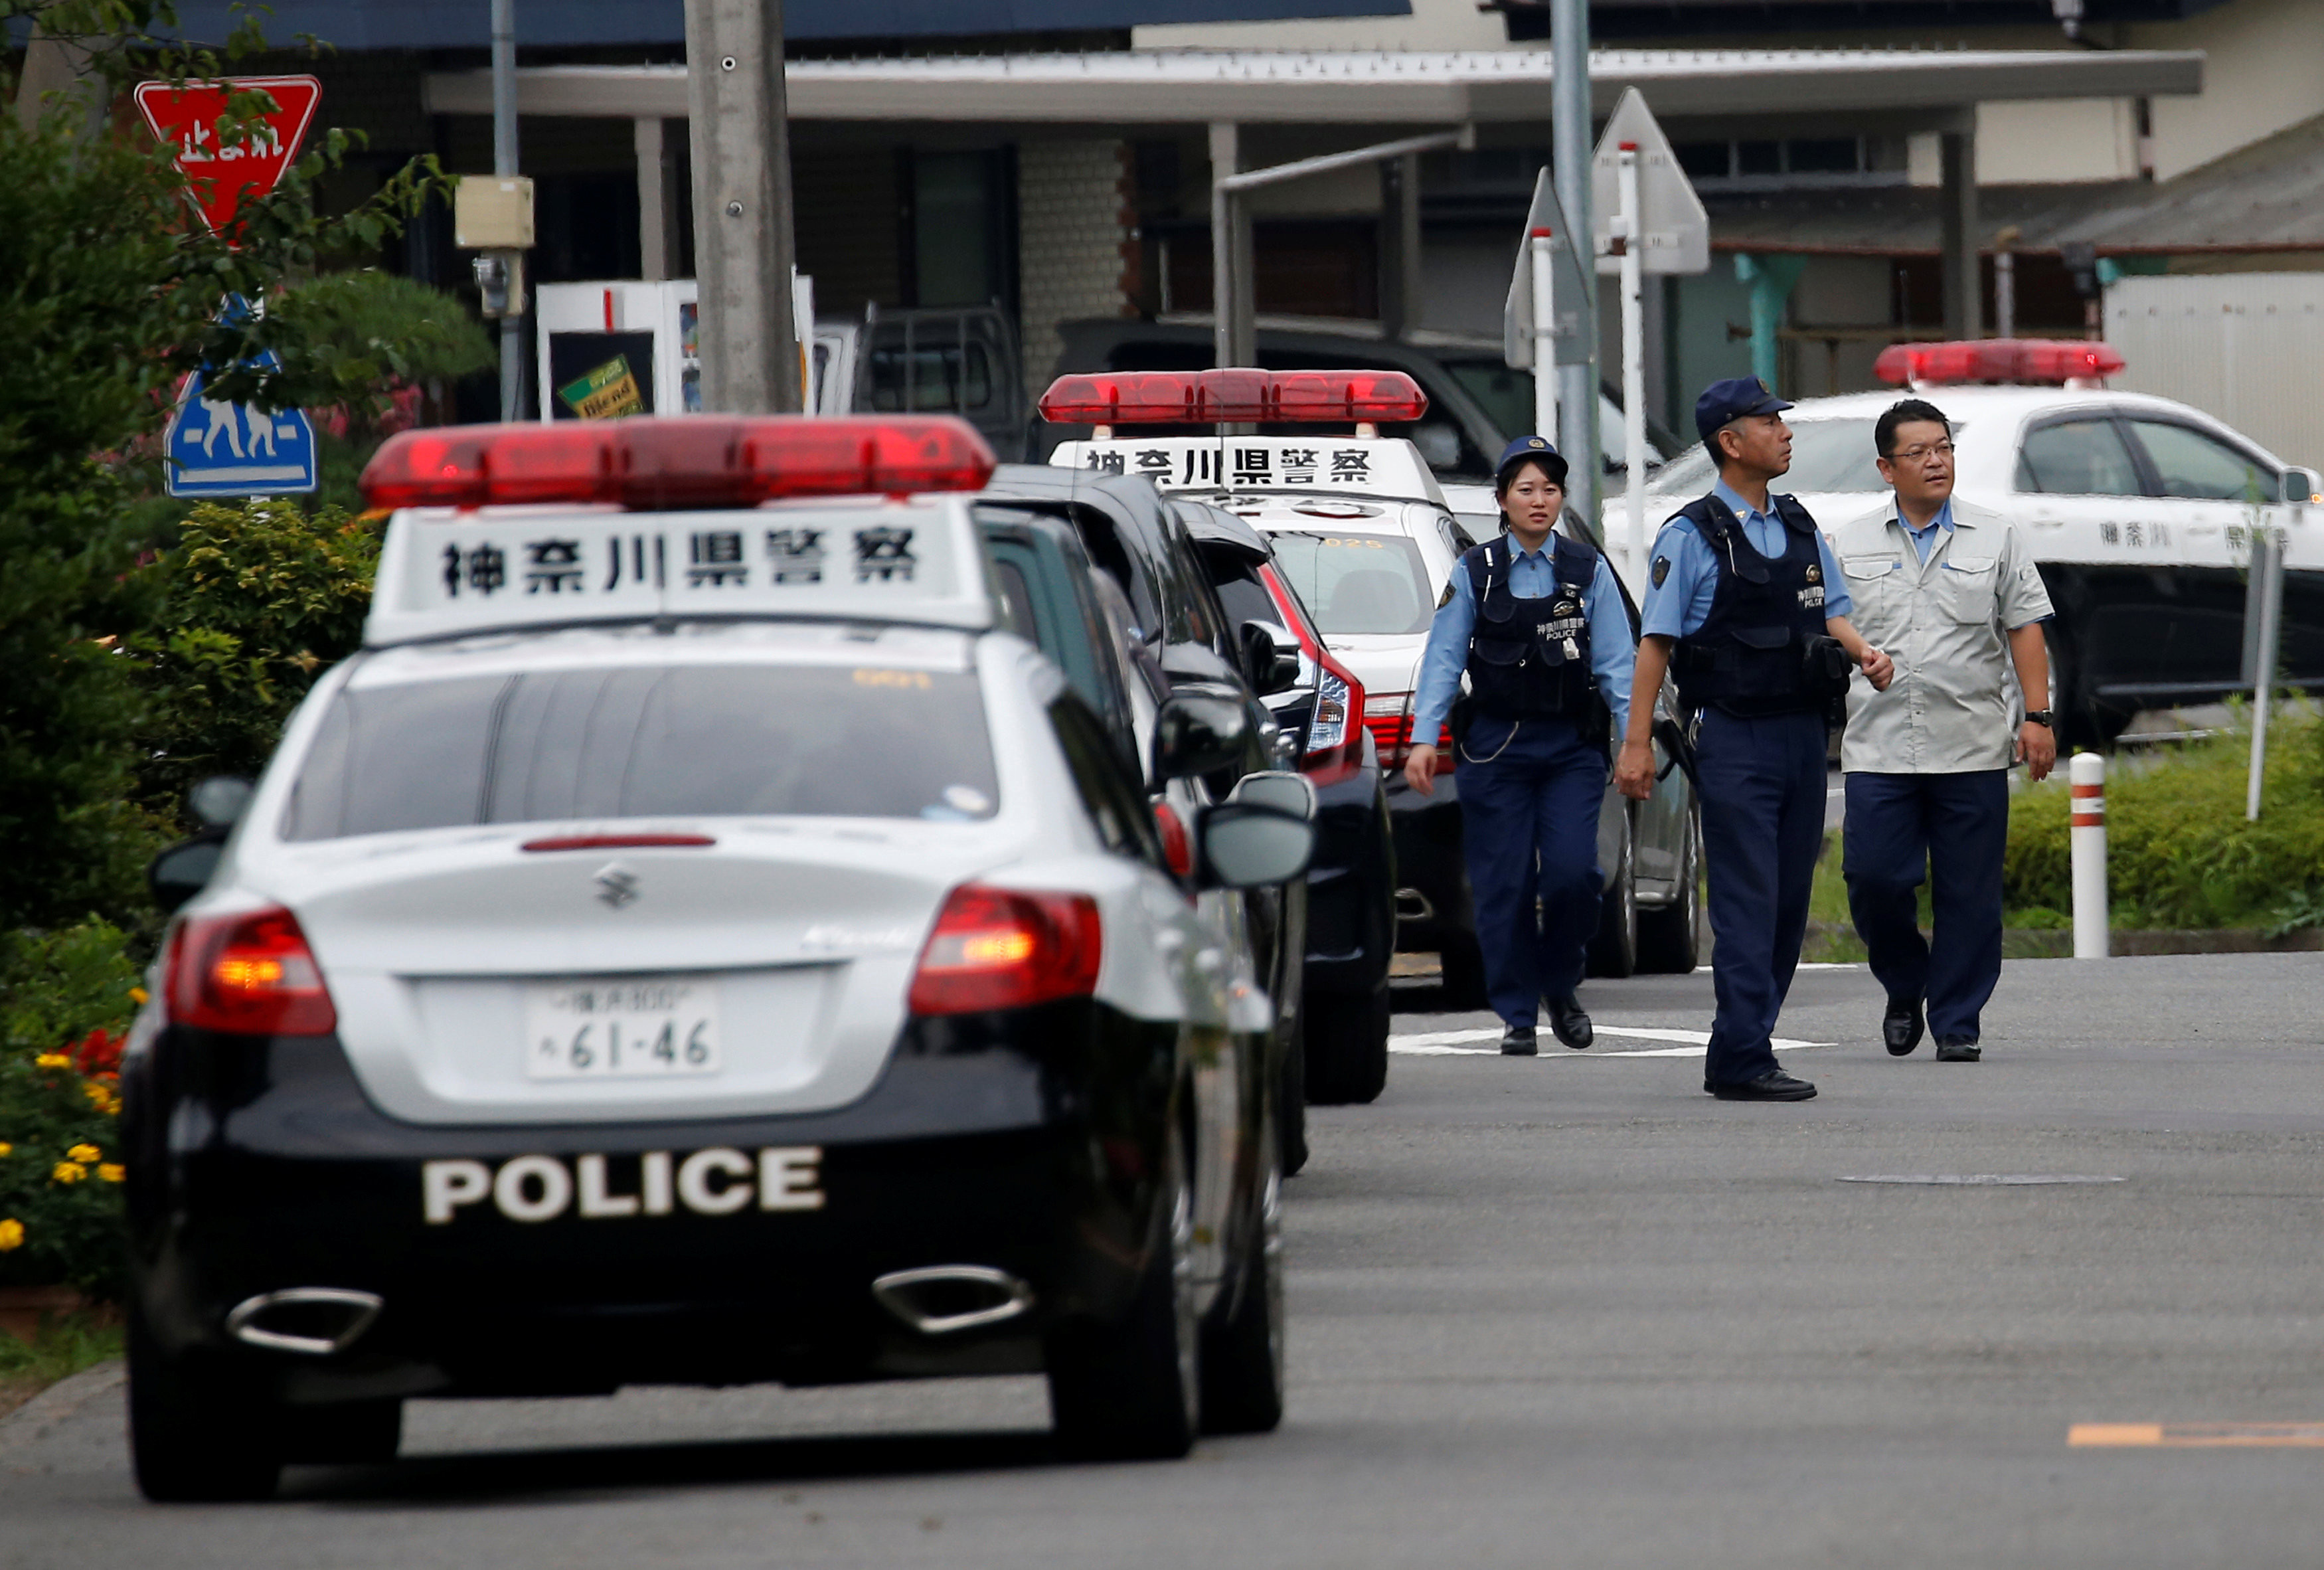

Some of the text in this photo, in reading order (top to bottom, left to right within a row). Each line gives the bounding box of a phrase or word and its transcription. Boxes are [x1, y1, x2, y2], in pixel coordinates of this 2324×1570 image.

[1087, 449, 1372, 484] 神奈川県警察
[442, 527, 917, 598] 神奈川県警察
[1325, 538, 1384, 550] 025
[1546, 629, 1576, 641] POLICE
[568, 1017, 709, 1068] 61-46
[422, 1146, 825, 1225] POLICE
